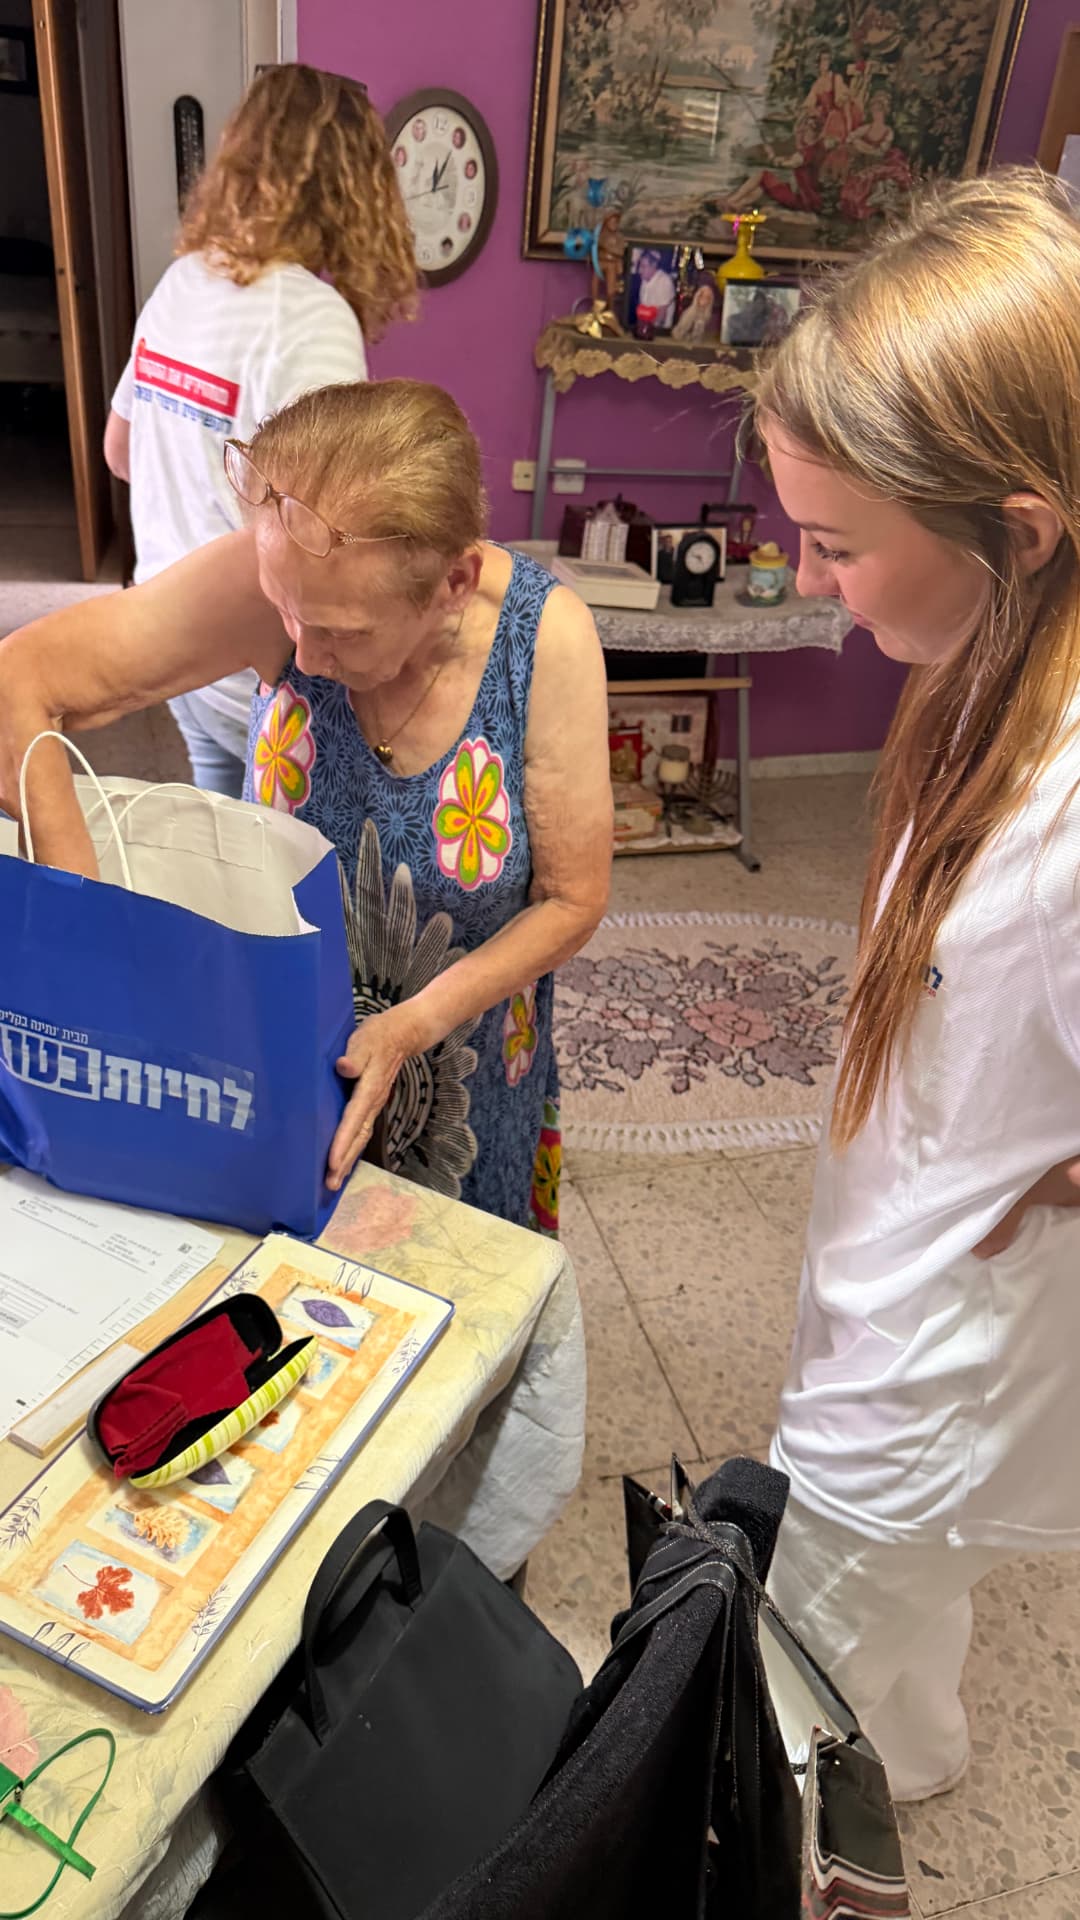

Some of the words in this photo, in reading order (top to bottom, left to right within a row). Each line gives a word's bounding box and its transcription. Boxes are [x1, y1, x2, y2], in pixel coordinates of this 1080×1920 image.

[7, 1028, 93, 1095] בטו
[62, 1028, 88, 1045] מבית
[104, 1055, 252, 1130] לחיות
